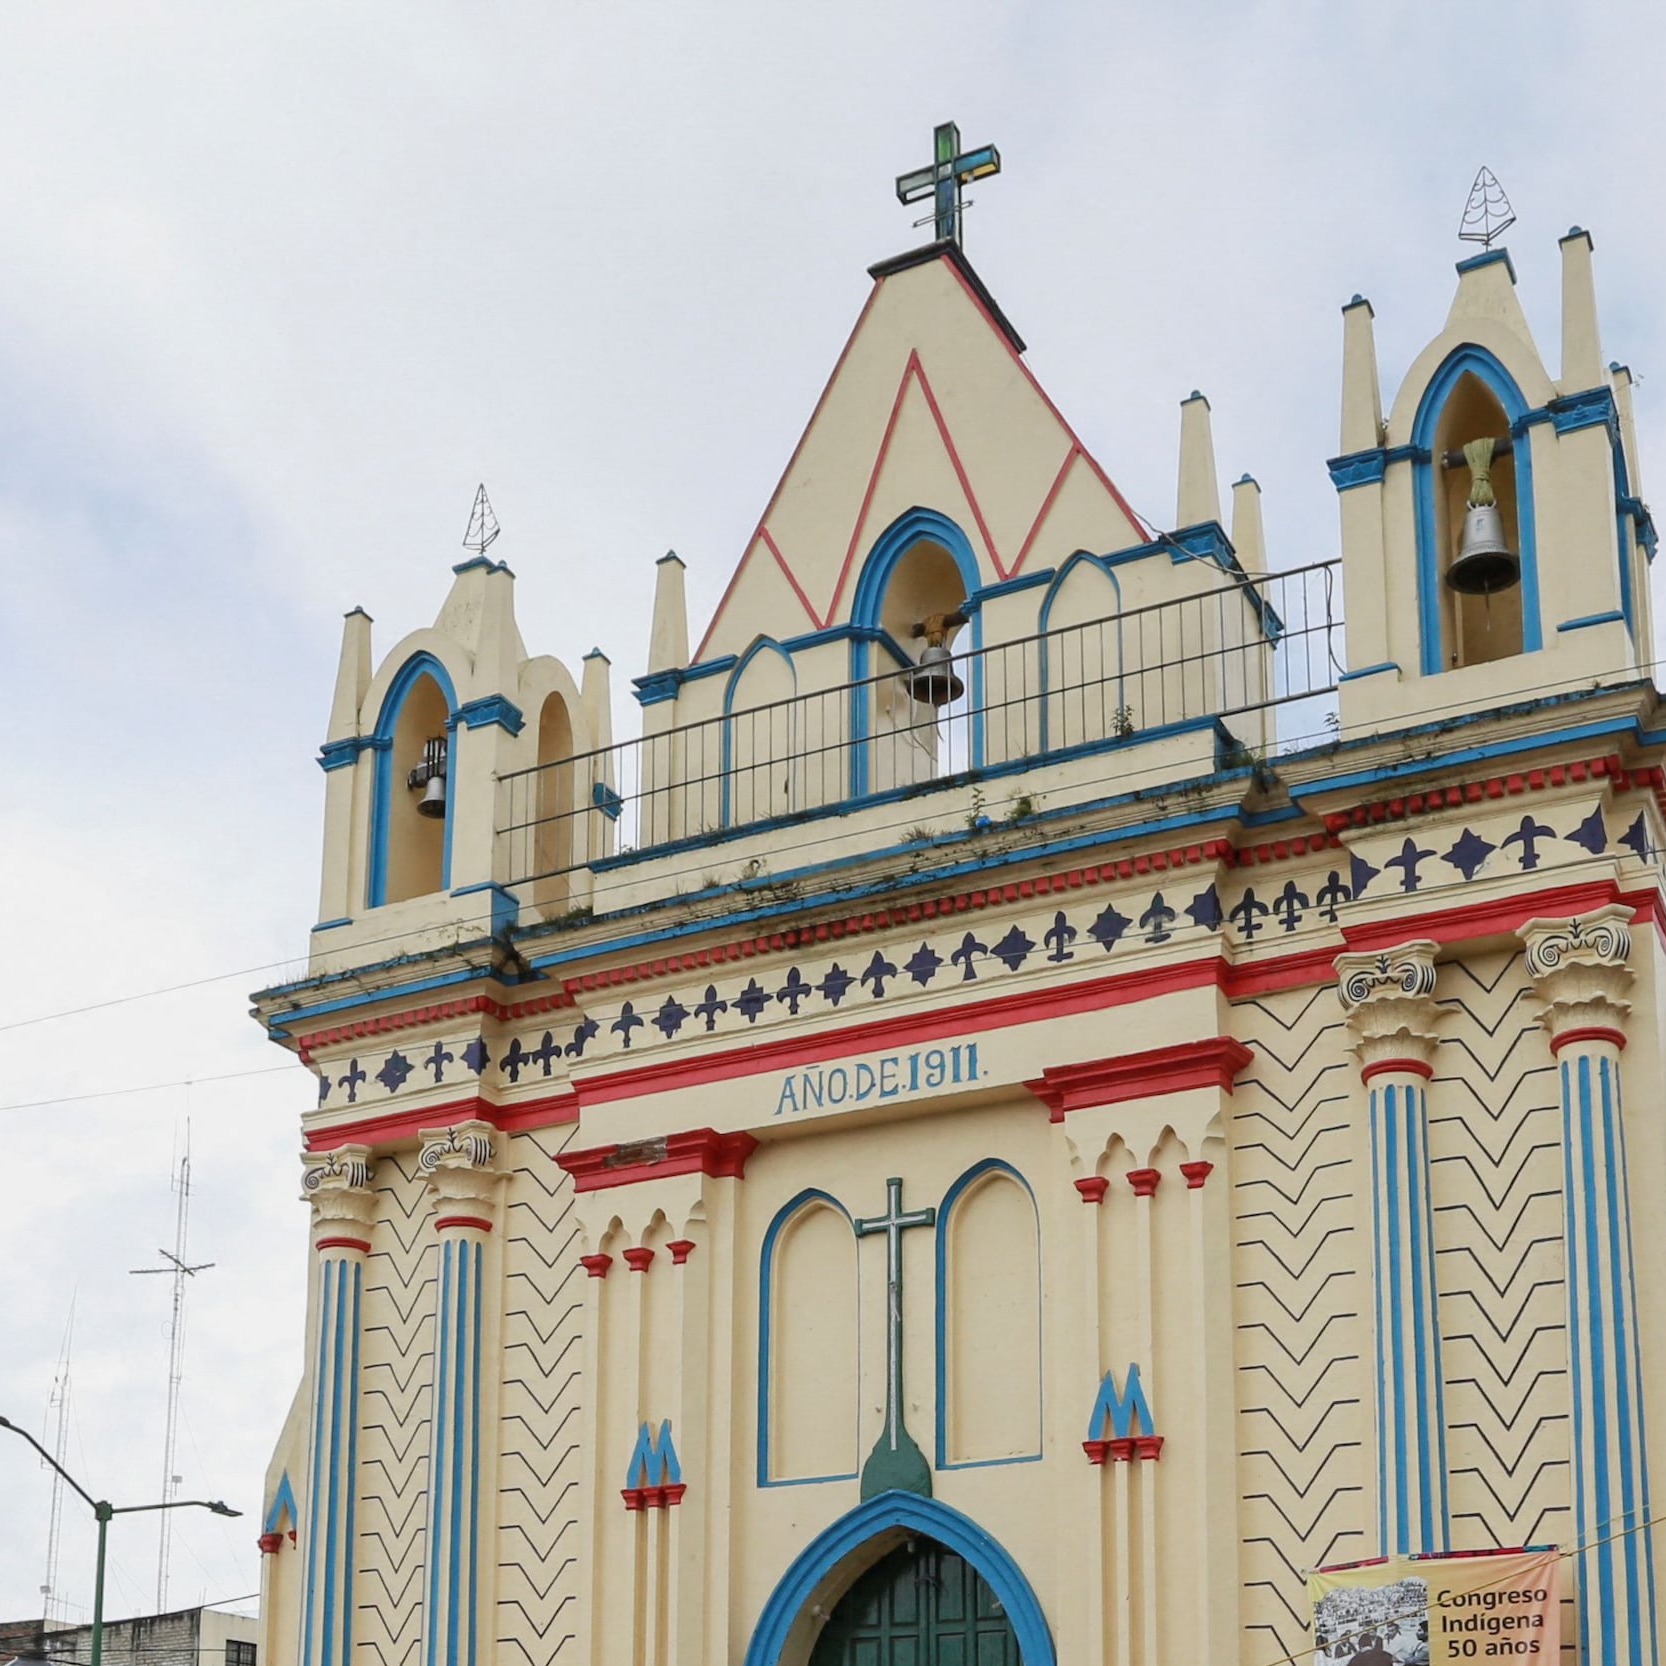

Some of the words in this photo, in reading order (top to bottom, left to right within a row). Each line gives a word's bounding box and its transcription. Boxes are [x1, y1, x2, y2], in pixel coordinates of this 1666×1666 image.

[1437, 1588, 1548, 1610] Congreso
[1442, 1612, 1544, 1635] Indígena
[1448, 1638, 1477, 1657] 50
[1485, 1636, 1541, 1656] años
